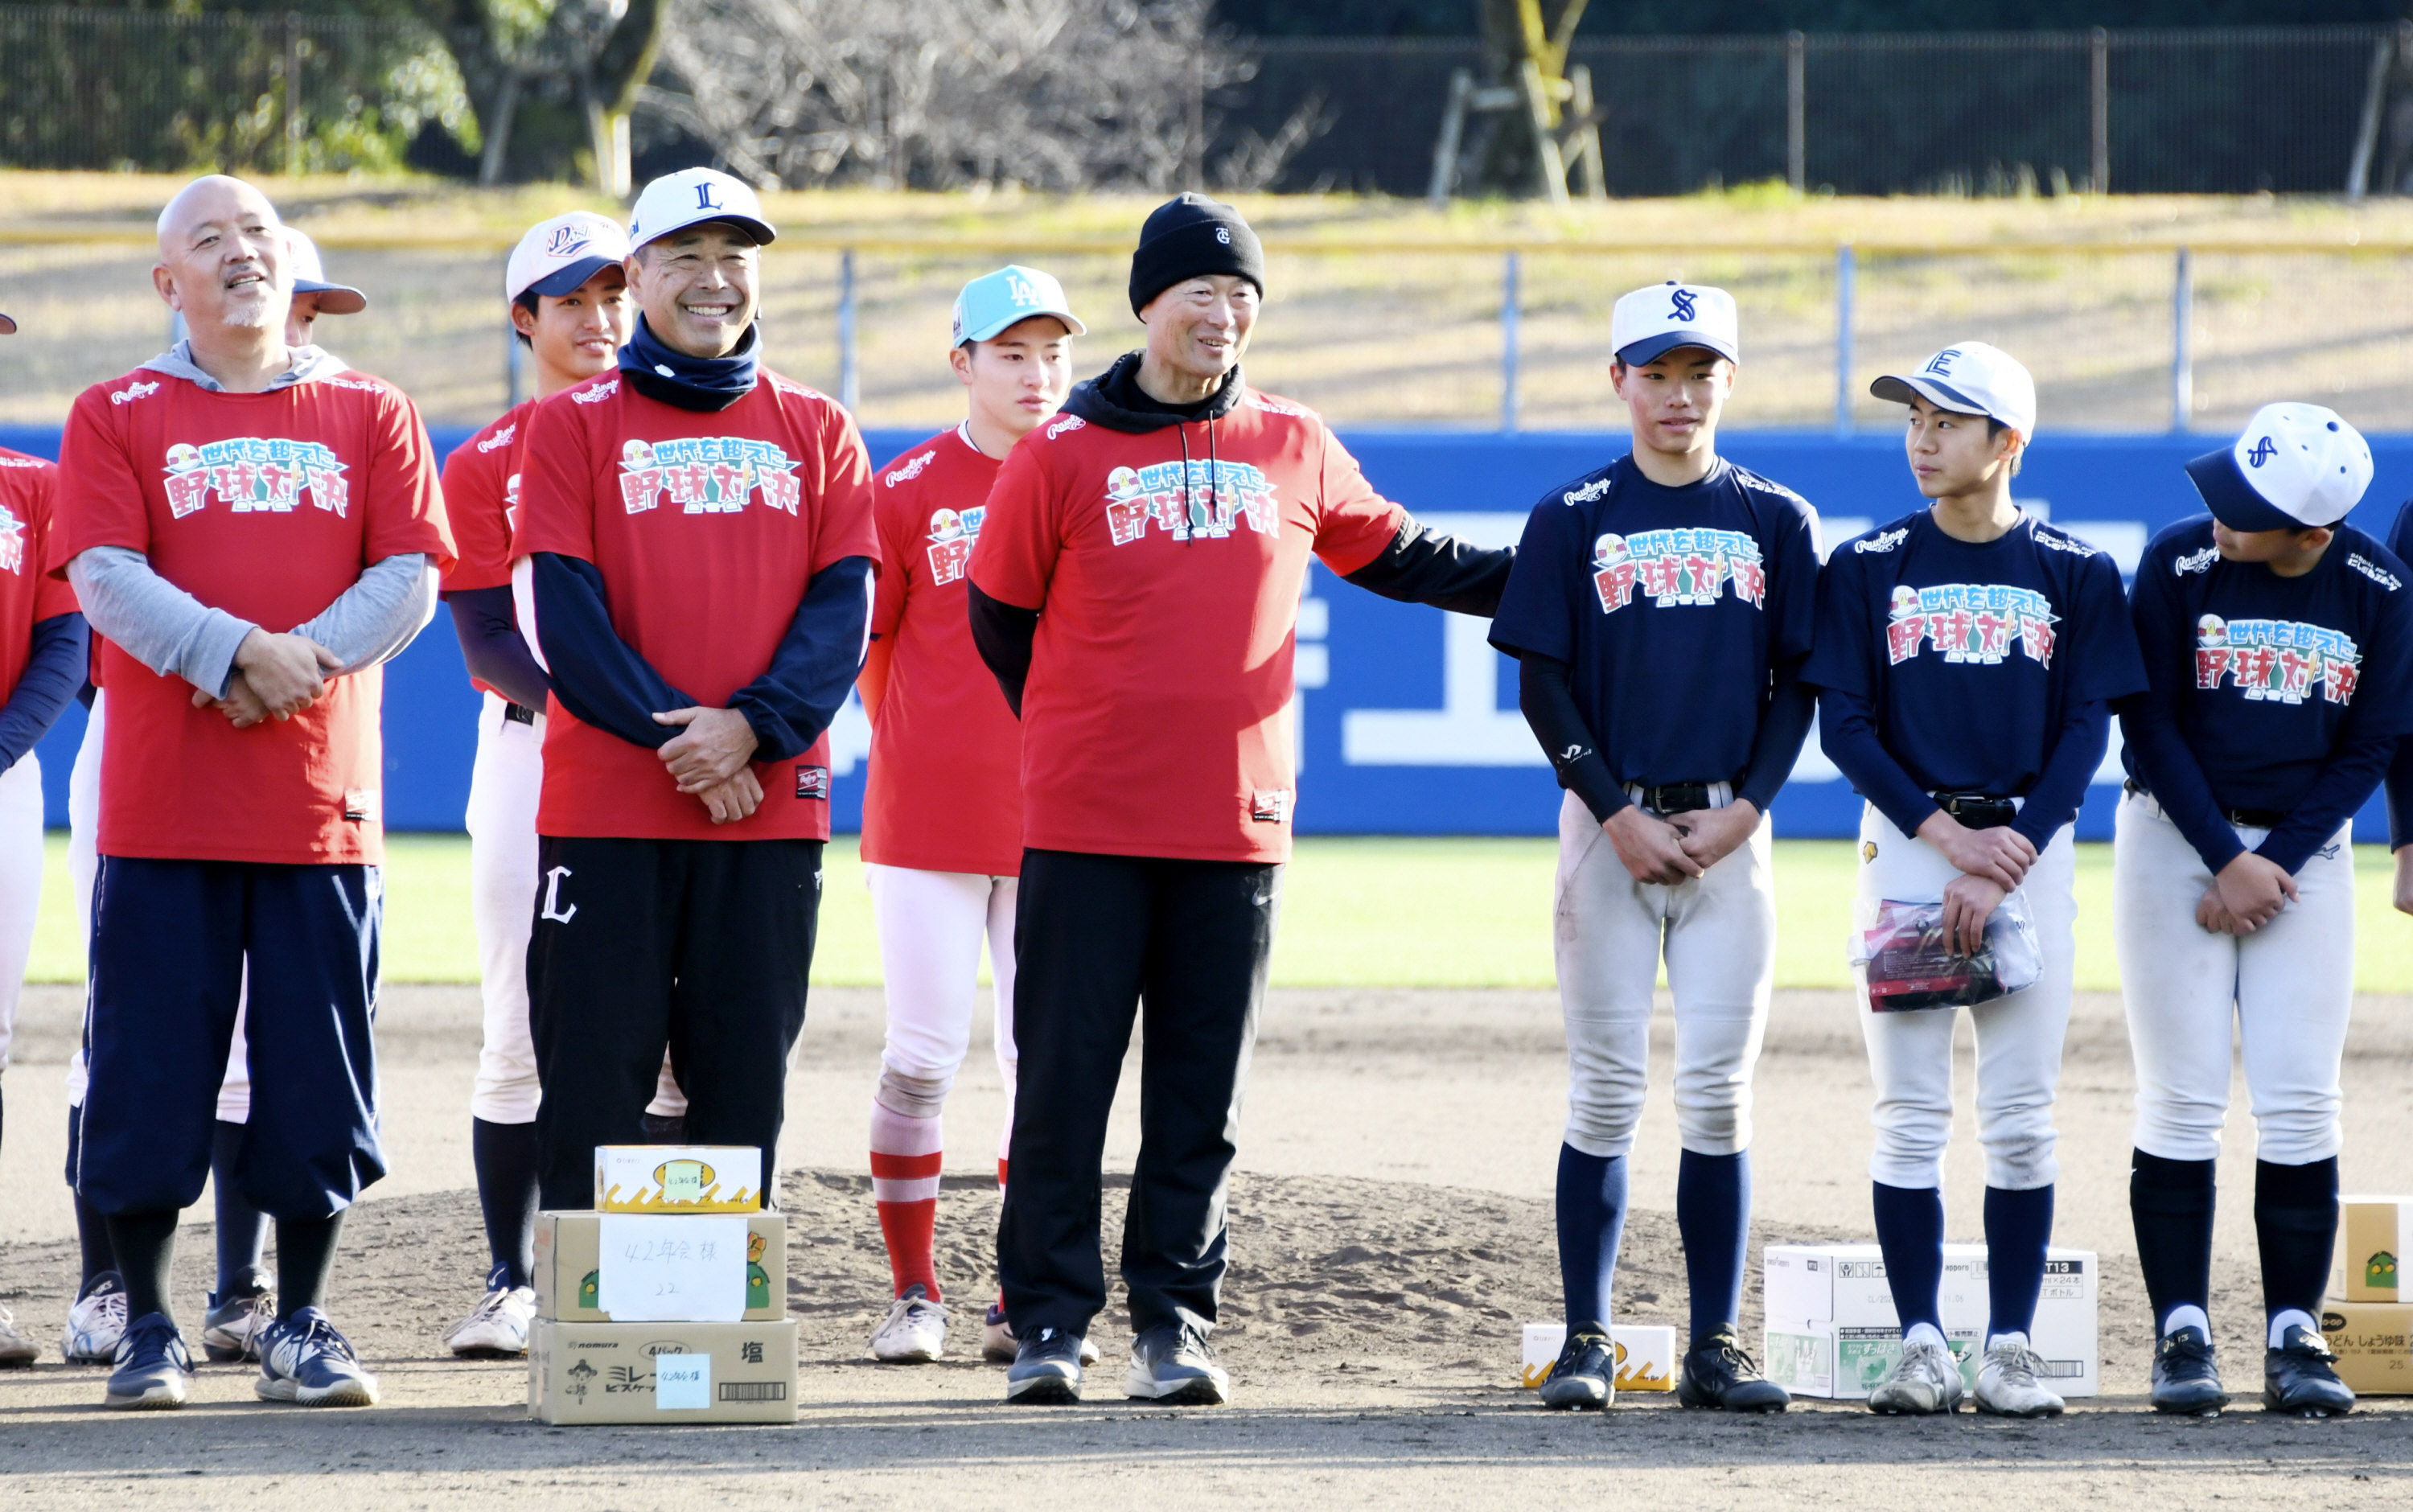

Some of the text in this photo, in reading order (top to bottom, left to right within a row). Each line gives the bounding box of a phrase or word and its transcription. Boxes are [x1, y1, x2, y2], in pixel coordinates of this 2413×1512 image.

[693, 182, 723, 210] L
[630, 218, 639, 240] al
[1006, 275, 1040, 306] LA
[1667, 289, 1698, 322] S
[572, 379, 619, 404] Rawlings
[200, 439, 335, 466] 世代を超えた
[654, 437, 787, 465] 世代を超えた
[886, 450, 936, 488] Rawlings
[1139, 460, 1265, 490] 世代を超えた
[166, 462, 347, 516] 野球対決
[622, 462, 800, 515] 野球対決
[1564, 478, 1611, 506] Rawlings
[1107, 486, 1279, 545] 野球対決
[1626, 528, 1760, 560] 世代を超えた
[1855, 528, 1909, 553] Rawlings
[928, 536, 970, 585] 野
[2176, 547, 2220, 577] Rawling
[1593, 555, 1765, 614] 野球対決
[1918, 585, 2051, 619] 世代を超えた
[1887, 610, 2056, 670] 野球対決
[2227, 619, 2358, 661] 世代を超えた
[2196, 646, 2360, 705] 野球対決
[541, 865, 577, 924] L
[656, 1282, 679, 1296] 22
[741, 1341, 764, 1364] 塩
[2389, 1359, 2404, 1370] 25
